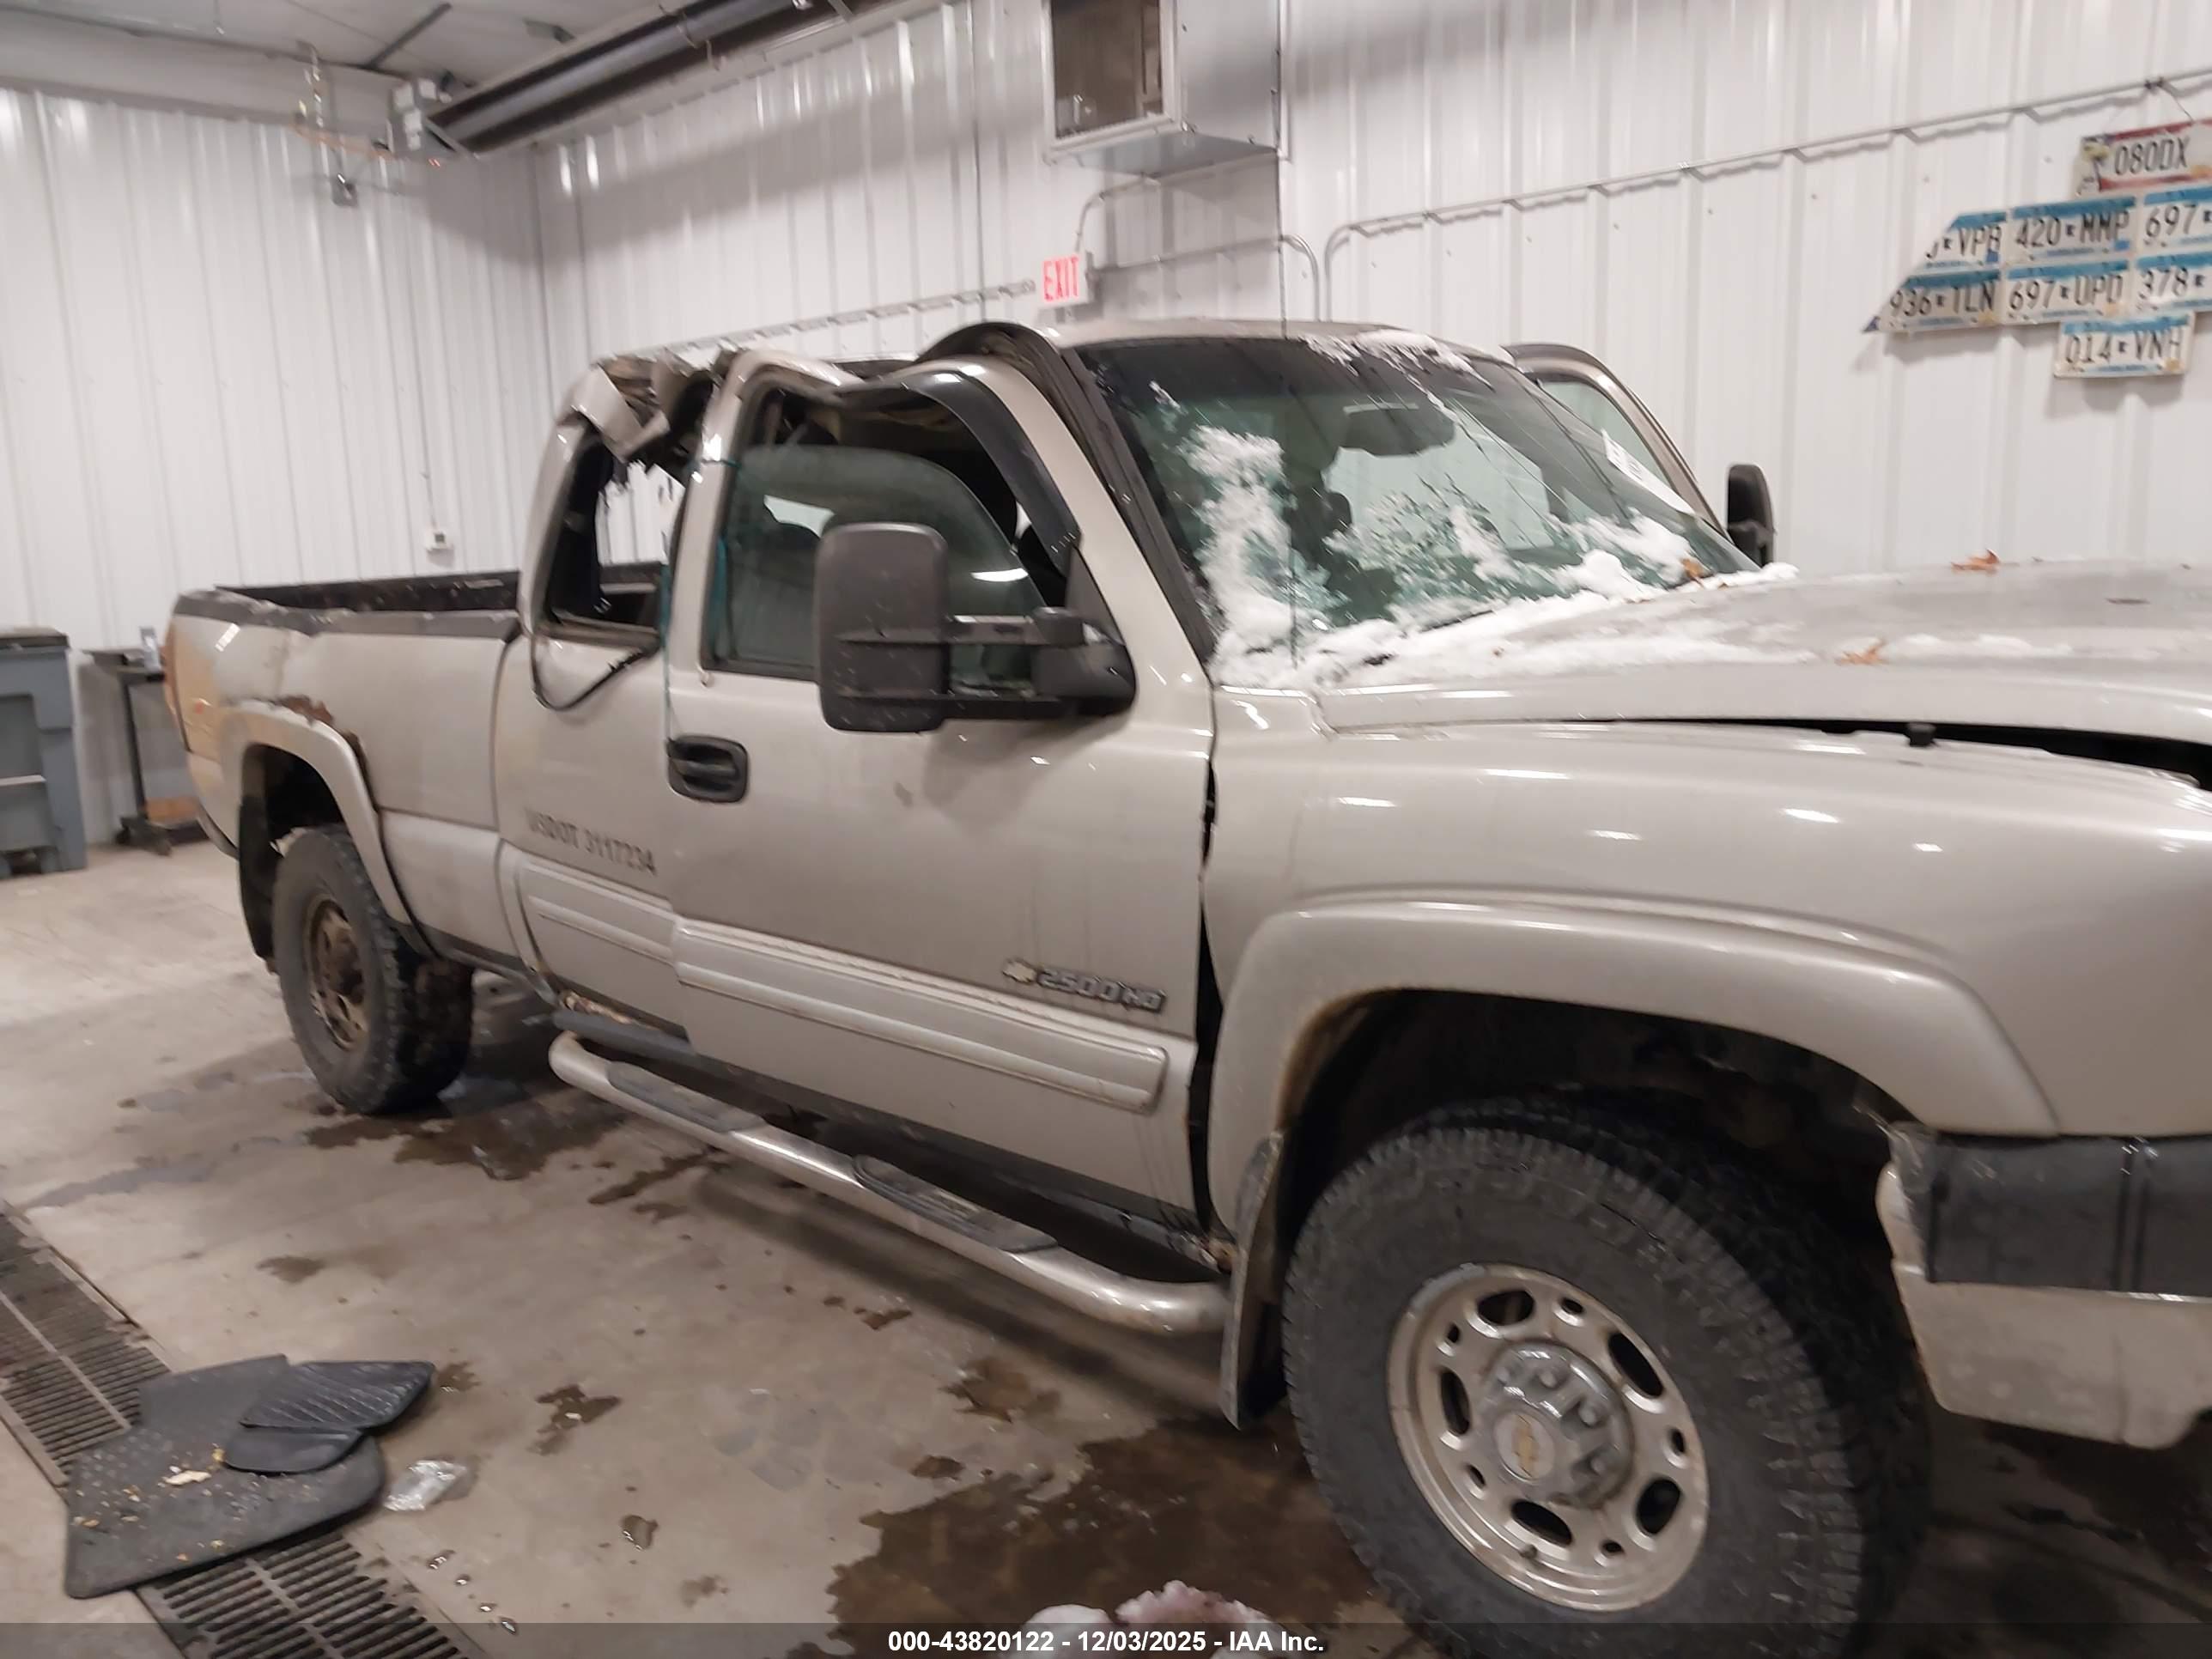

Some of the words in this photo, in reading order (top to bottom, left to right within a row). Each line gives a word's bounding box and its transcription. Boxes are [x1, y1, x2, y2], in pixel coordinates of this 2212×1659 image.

[2015, 215, 2061, 248] 420
[2145, 202, 2197, 238] 697
[1042, 256, 1079, 302] EXIT
[2008, 276, 2056, 311] 697
[2136, 266, 2189, 300] 378
[1889, 285, 1932, 318] 936
[2064, 334, 2112, 364] 014
